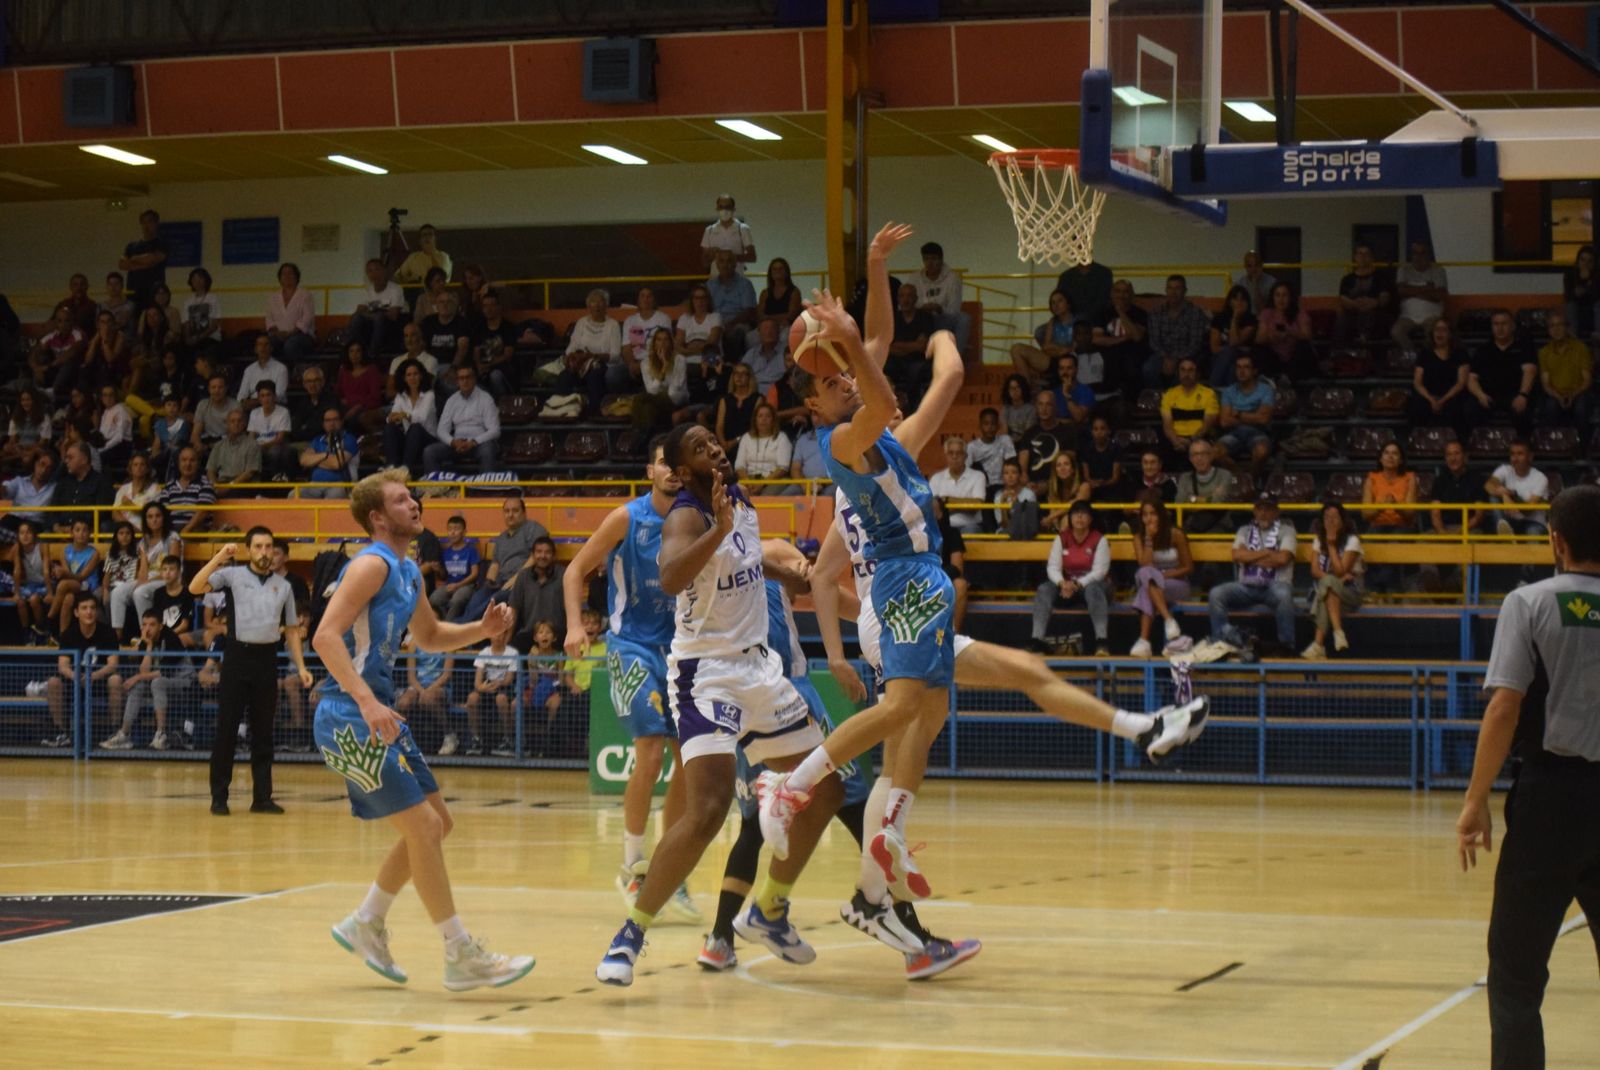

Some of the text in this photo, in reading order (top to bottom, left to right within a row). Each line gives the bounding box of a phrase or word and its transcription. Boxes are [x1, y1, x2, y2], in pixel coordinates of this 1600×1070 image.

[1283, 150, 1380, 166] Schelde
[1283, 165, 1380, 187] Sports
[840, 506, 860, 554] 5
[732, 530, 746, 556] 0
